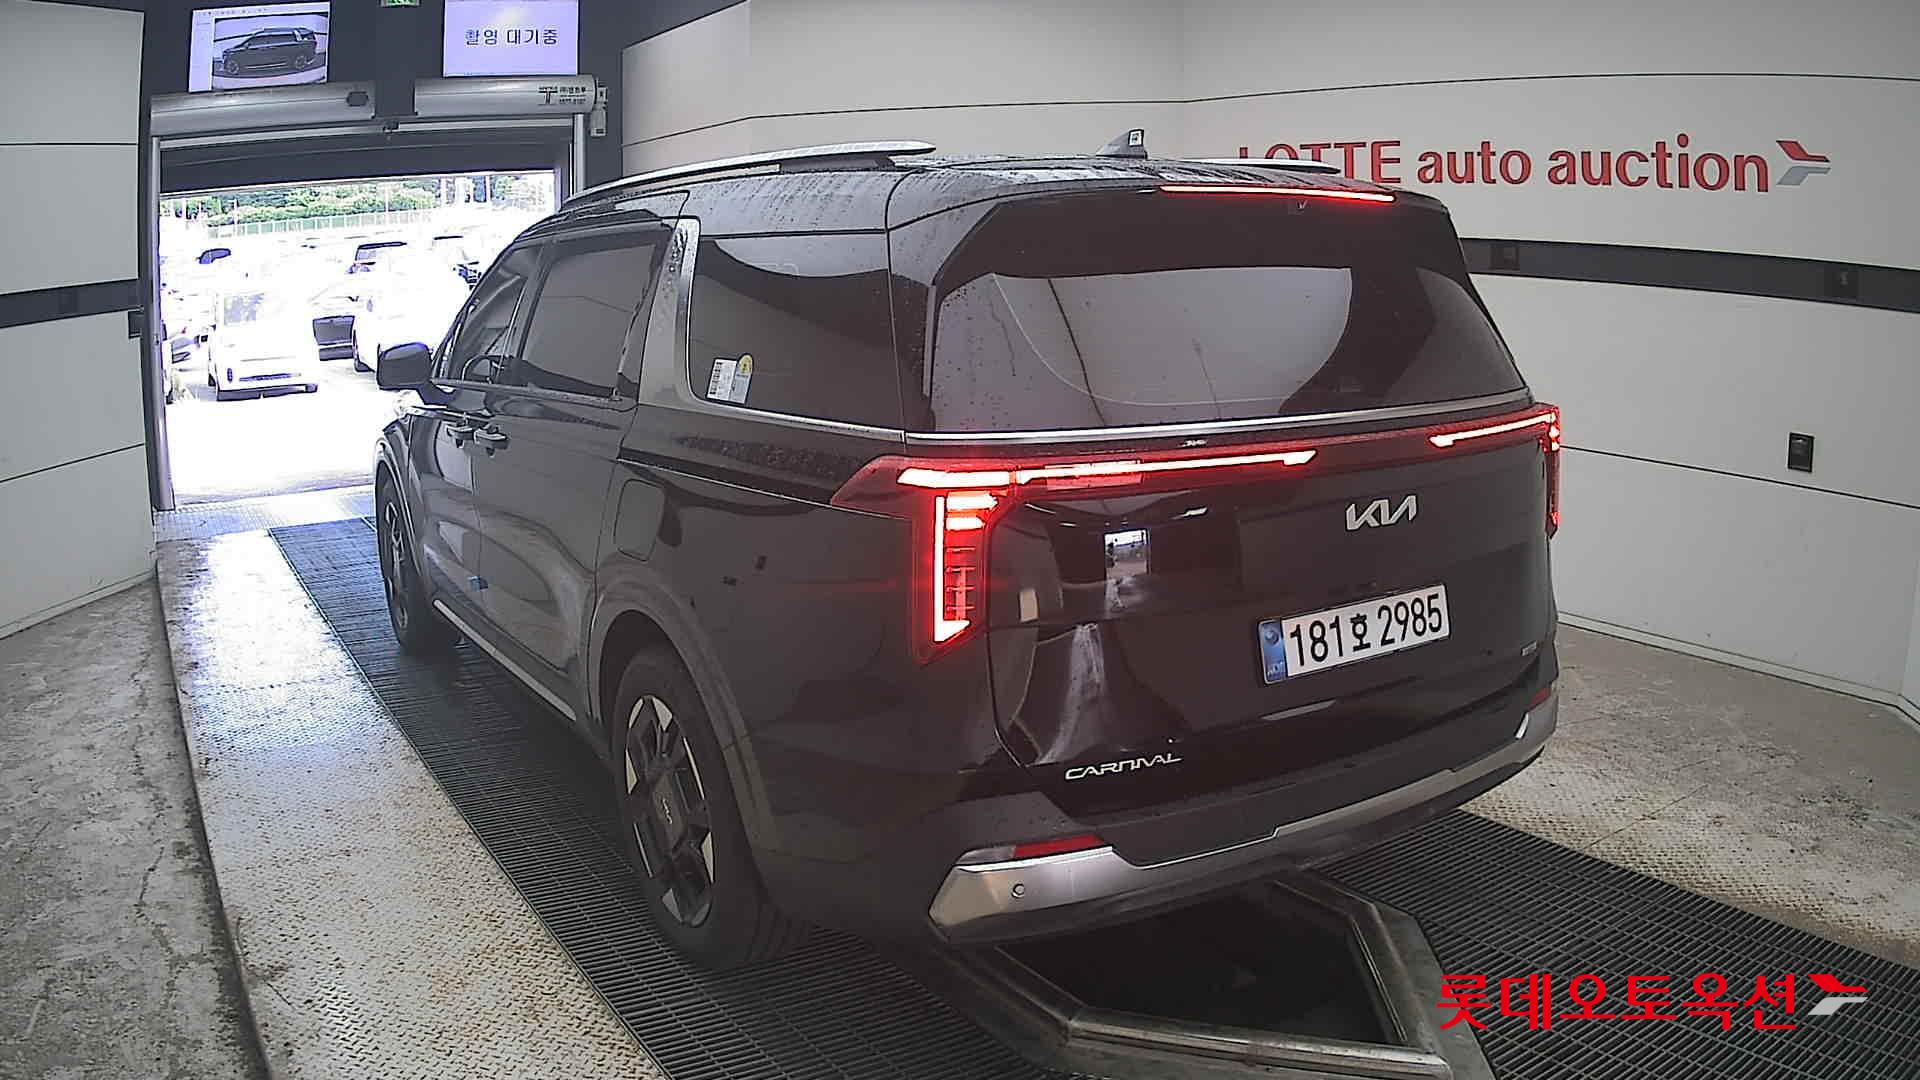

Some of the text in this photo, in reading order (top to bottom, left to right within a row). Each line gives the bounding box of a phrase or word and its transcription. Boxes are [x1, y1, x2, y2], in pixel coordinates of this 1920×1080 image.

[506, 29, 559, 45] 대기중
[1417, 141, 1532, 185] auto
[1547, 133, 1769, 193] auction
[1346, 495, 1417, 530] KIA
[1377, 593, 1442, 647] 2985
[1065, 753, 1182, 779] CARNIVAL
